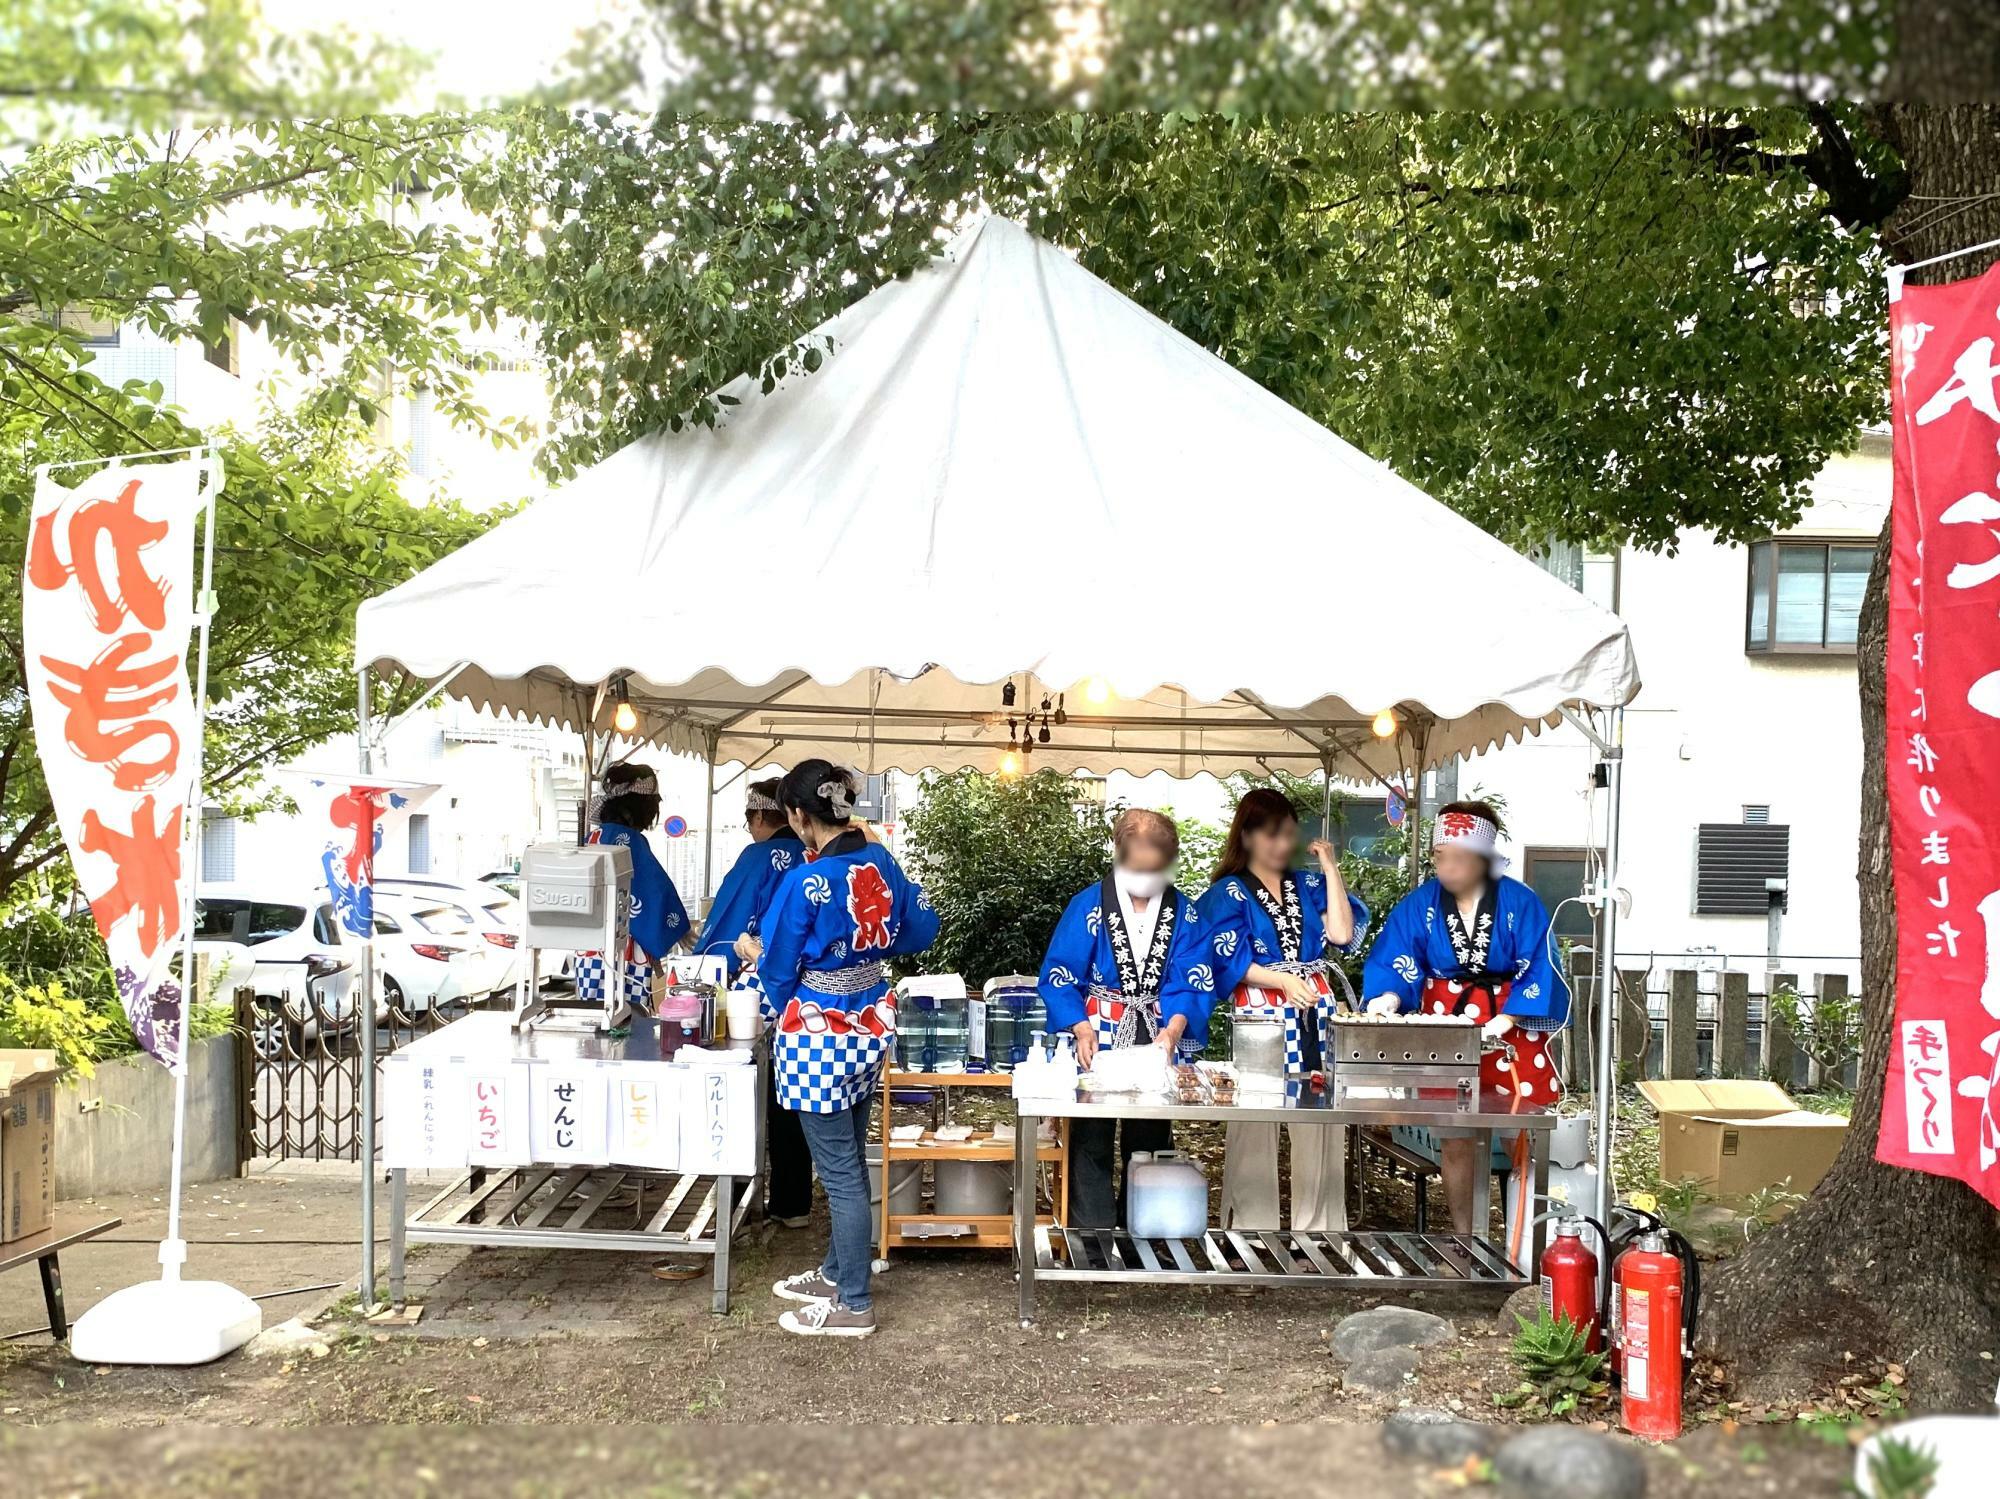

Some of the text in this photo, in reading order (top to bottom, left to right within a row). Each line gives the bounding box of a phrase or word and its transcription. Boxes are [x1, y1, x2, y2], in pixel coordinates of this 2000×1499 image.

[1443, 812, 1476, 837] 祭
[532, 887, 588, 907] Swan
[477, 1081, 501, 1150] いちご
[554, 1083, 576, 1148] せんじ
[710, 1076, 724, 1162] ブルーハワイ
